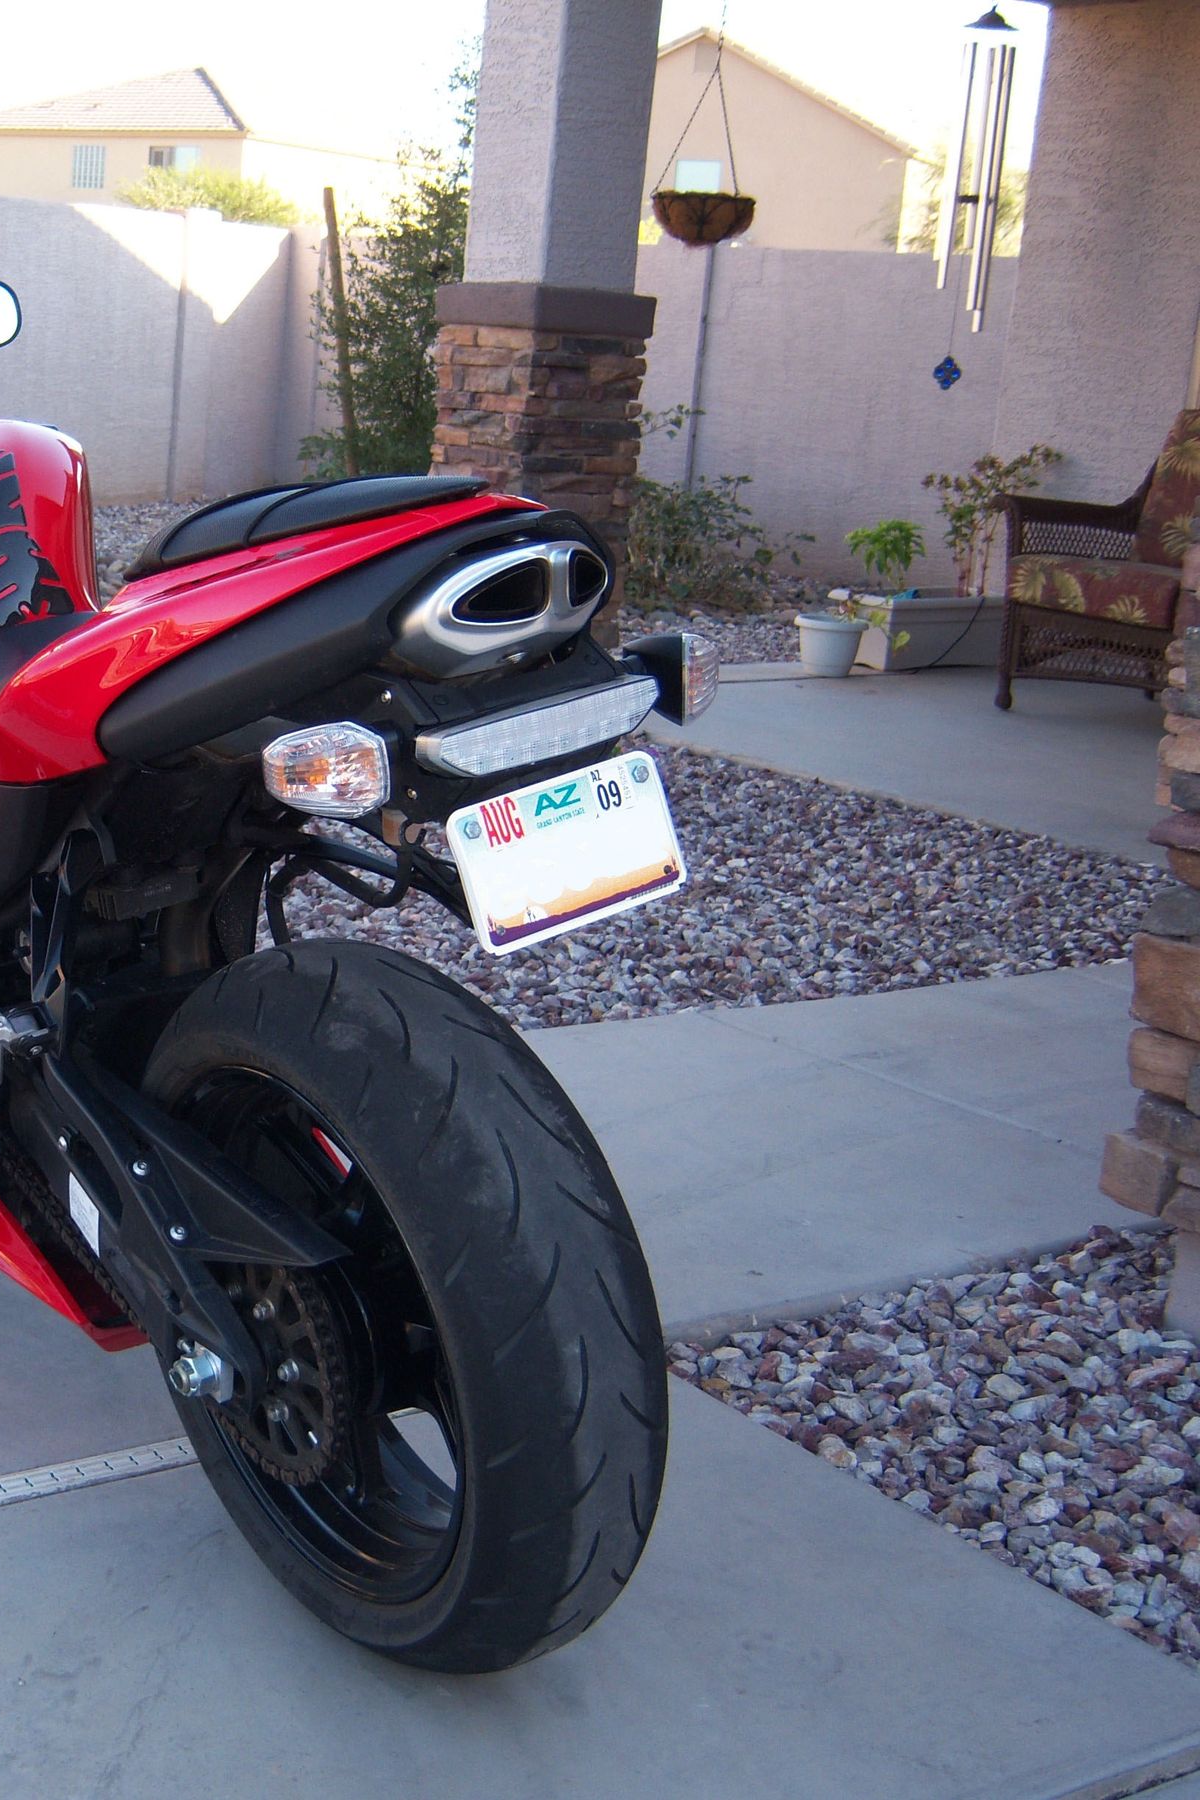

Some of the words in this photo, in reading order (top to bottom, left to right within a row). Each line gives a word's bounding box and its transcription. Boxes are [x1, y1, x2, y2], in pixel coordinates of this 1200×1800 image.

[590, 769, 602, 783] AZ
[534, 783, 581, 816] AZ
[597, 780, 622, 811] 09
[480, 796, 525, 848] AUG
